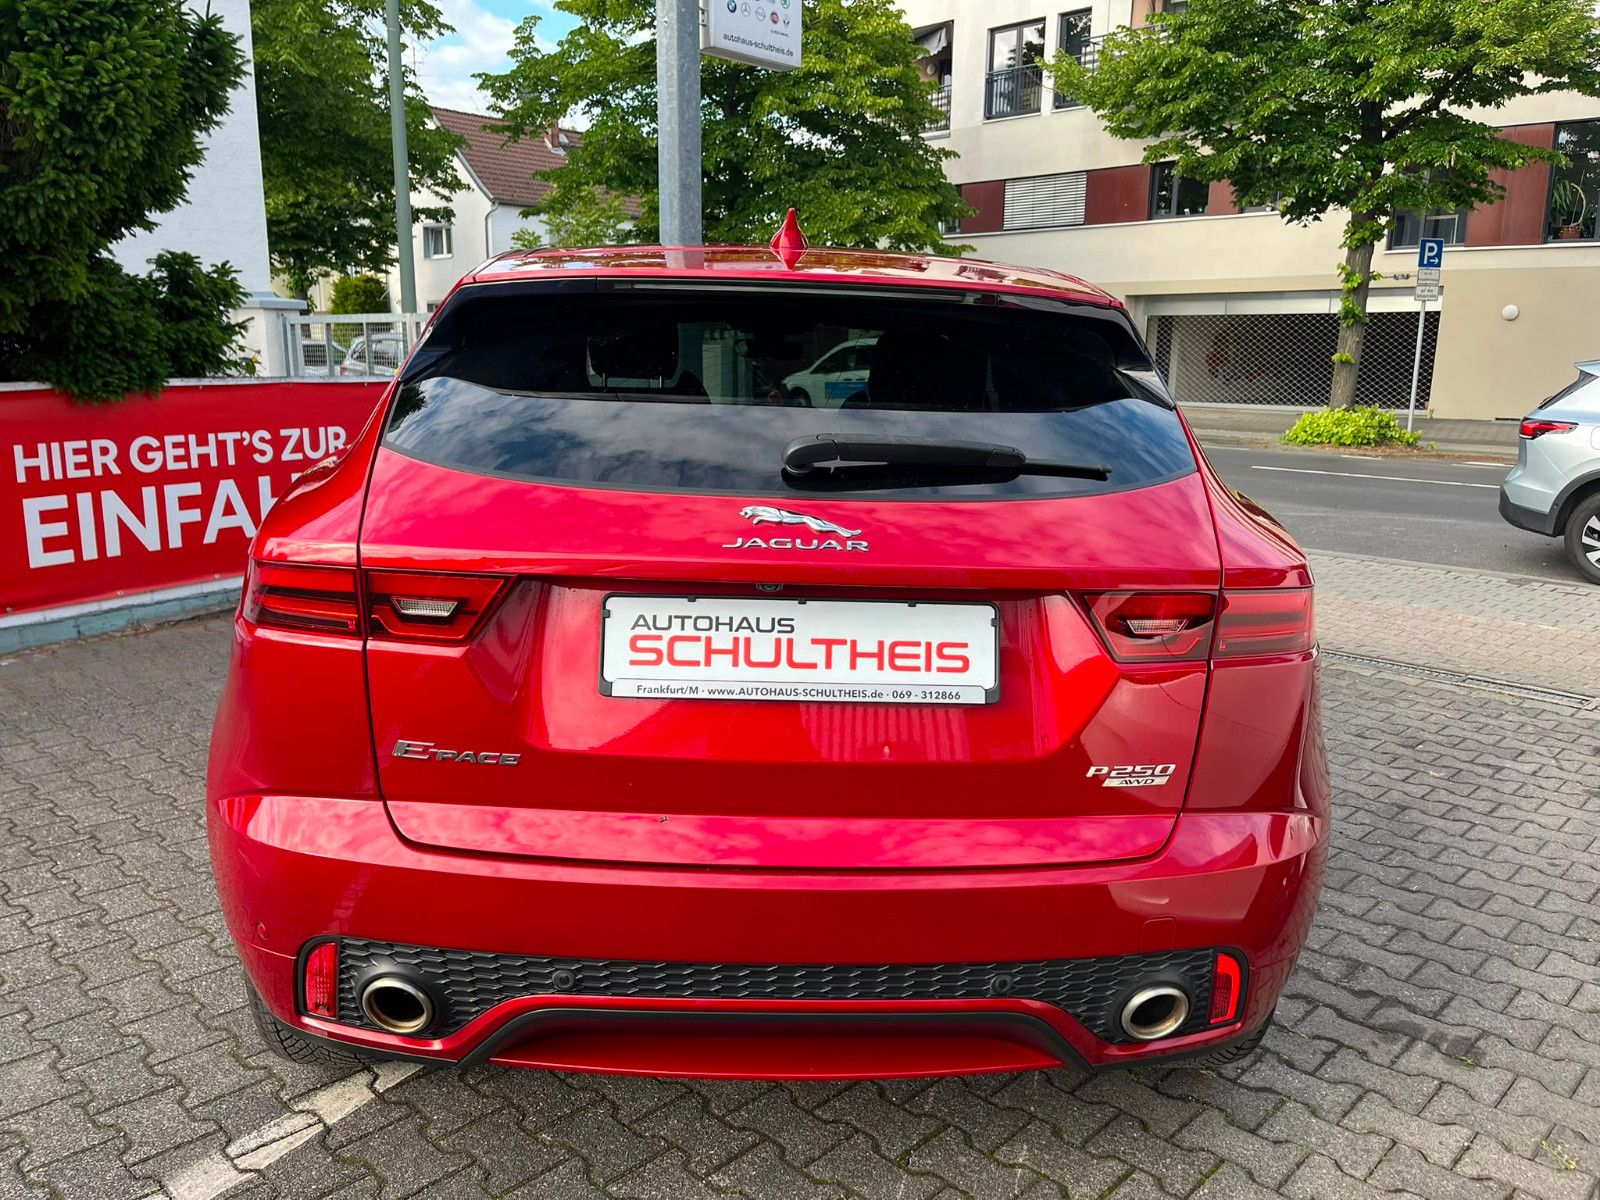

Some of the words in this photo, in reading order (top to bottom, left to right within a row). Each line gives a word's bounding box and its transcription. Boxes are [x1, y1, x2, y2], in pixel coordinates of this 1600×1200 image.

[723, 33, 793, 56] autohaus-schultheis.de
[1423, 242, 1438, 265] P
[13, 438, 121, 483] HIER
[279, 425, 348, 462] ZUR
[722, 537, 869, 552] JAGUAR
[630, 614, 795, 634] AUTOHAUS
[628, 634, 970, 673] SCHULTHEIS
[636, 684, 699, 695] Frankfurt/M
[708, 686, 884, 699] www.AUTOHAUS-SCHULTHEIS.de
[892, 690, 912, 699] 069
[920, 690, 961, 700] 312866
[1085, 763, 1176, 778] P250
